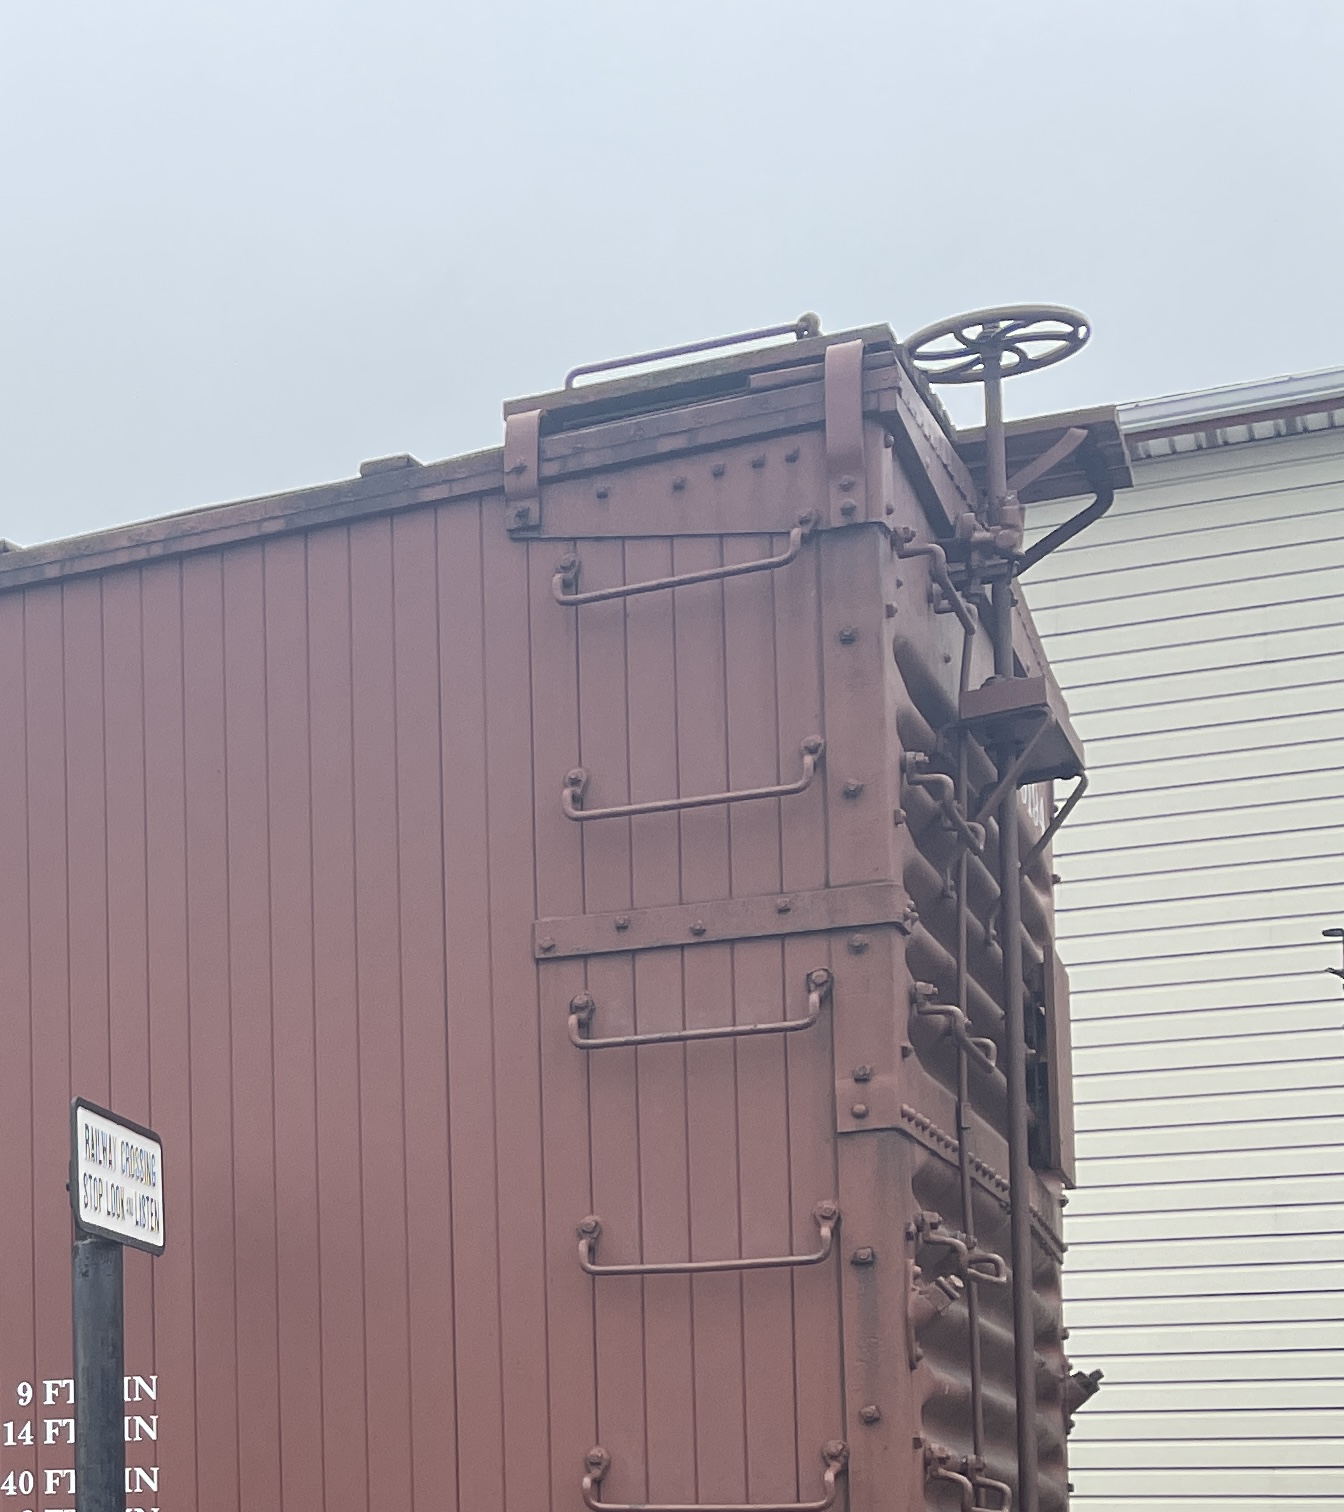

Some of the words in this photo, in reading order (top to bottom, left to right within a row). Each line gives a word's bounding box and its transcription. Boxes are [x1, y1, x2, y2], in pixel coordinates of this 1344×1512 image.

[84, 1123, 118, 1172] RAILWAY
[120, 1140, 157, 1187] CROSSING
[83, 1172, 104, 1214] STOP
[106, 1180, 126, 1220] LOOK
[134, 1191, 160, 1233] LISTEN
[17, 1381, 33, 1406] 9
[123, 1375, 158, 1402] IN
[3, 1420, 34, 1446] 14
[124, 1414, 159, 1442] IN
[0, 1470, 34, 1496] 40
[124, 1466, 160, 1493] IN
